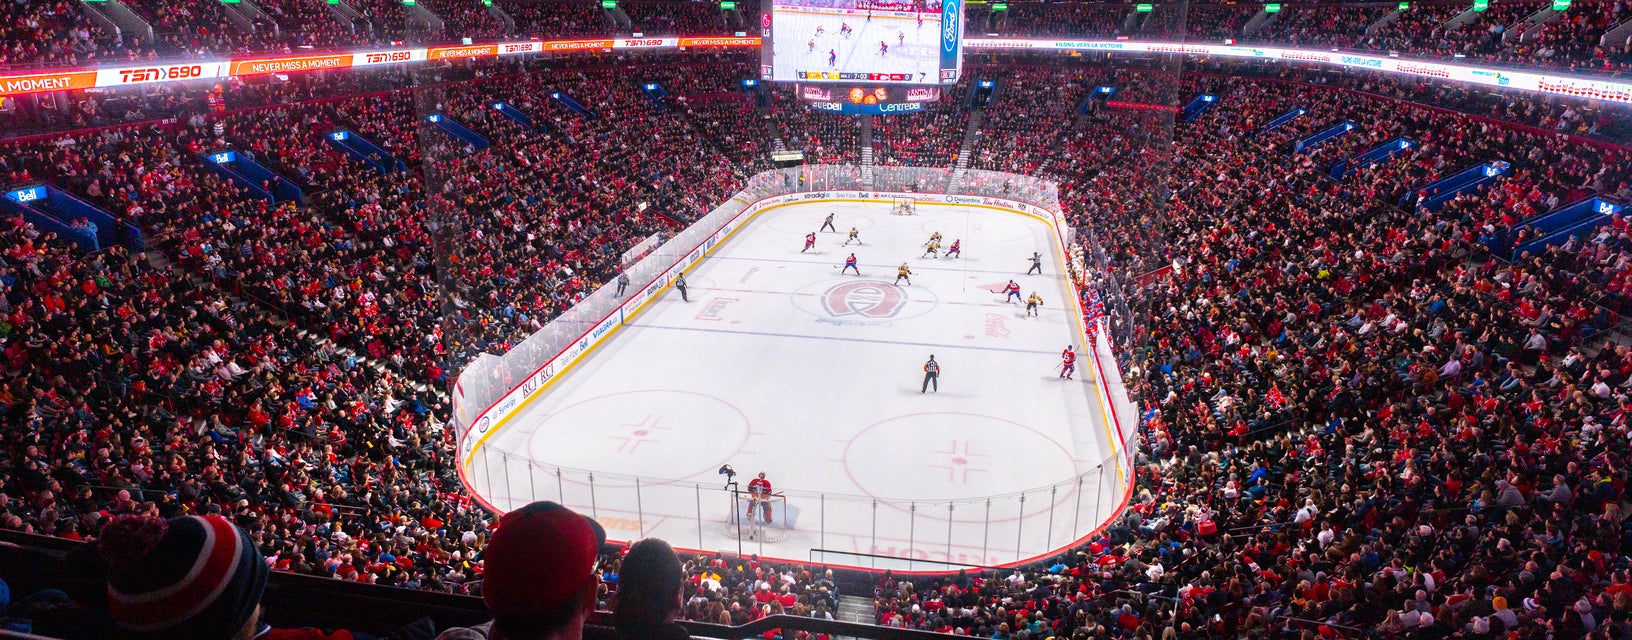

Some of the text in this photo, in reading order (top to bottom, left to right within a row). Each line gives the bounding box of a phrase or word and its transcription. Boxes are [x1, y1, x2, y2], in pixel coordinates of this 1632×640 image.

[945, 11, 955, 42] Ford
[252, 63, 281, 72] NEVER
[282, 62, 301, 70] MISS
[308, 58, 340, 68] MOMENT
[7, 77, 71, 92] MOMENT
[18, 188, 37, 202] Bell
[1600, 202, 1613, 214] Bell
